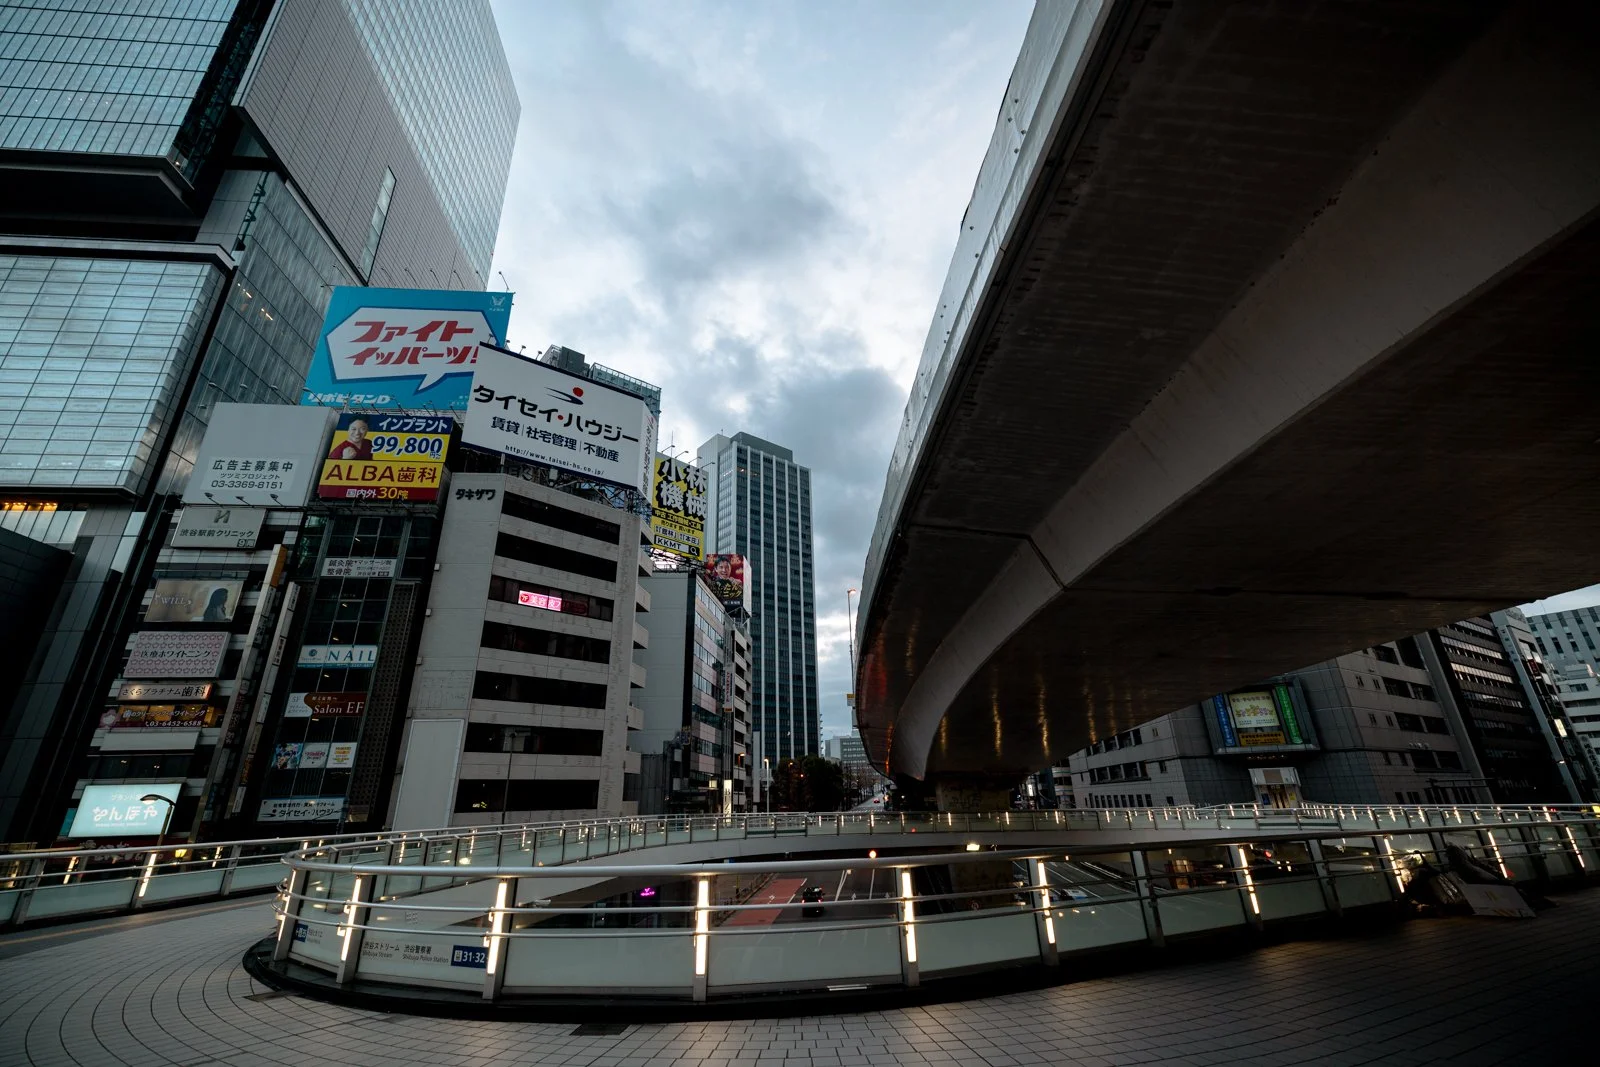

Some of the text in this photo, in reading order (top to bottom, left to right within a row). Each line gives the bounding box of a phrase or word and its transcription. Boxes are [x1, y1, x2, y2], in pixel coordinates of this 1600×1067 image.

[349, 320, 475, 343] ファイト
[307, 392, 392, 404] リポビタンD
[379, 417, 448, 432] インプラント
[372, 436, 443, 455] 99,800
[490, 416, 620, 463] 賃貸 社宅管理 不動産
[212, 459, 293, 472] 広告主募集中
[660, 460, 708, 489] 小林
[211, 480, 283, 489] 03-3369-8151
[658, 482, 708, 519] 機械
[180, 529, 254, 538] 渋谷駅前クリニック
[657, 537, 681, 550] KKMT
[139, 649, 211, 658] 医療ホワイトニング
[328, 650, 375, 662] NAIL
[313, 704, 342, 714] Salon
[346, 701, 365, 713] EF
[92, 805, 158, 822] なんぼや
[363, 941, 433, 955] 渋谷ストリーム 渋谷警察署
